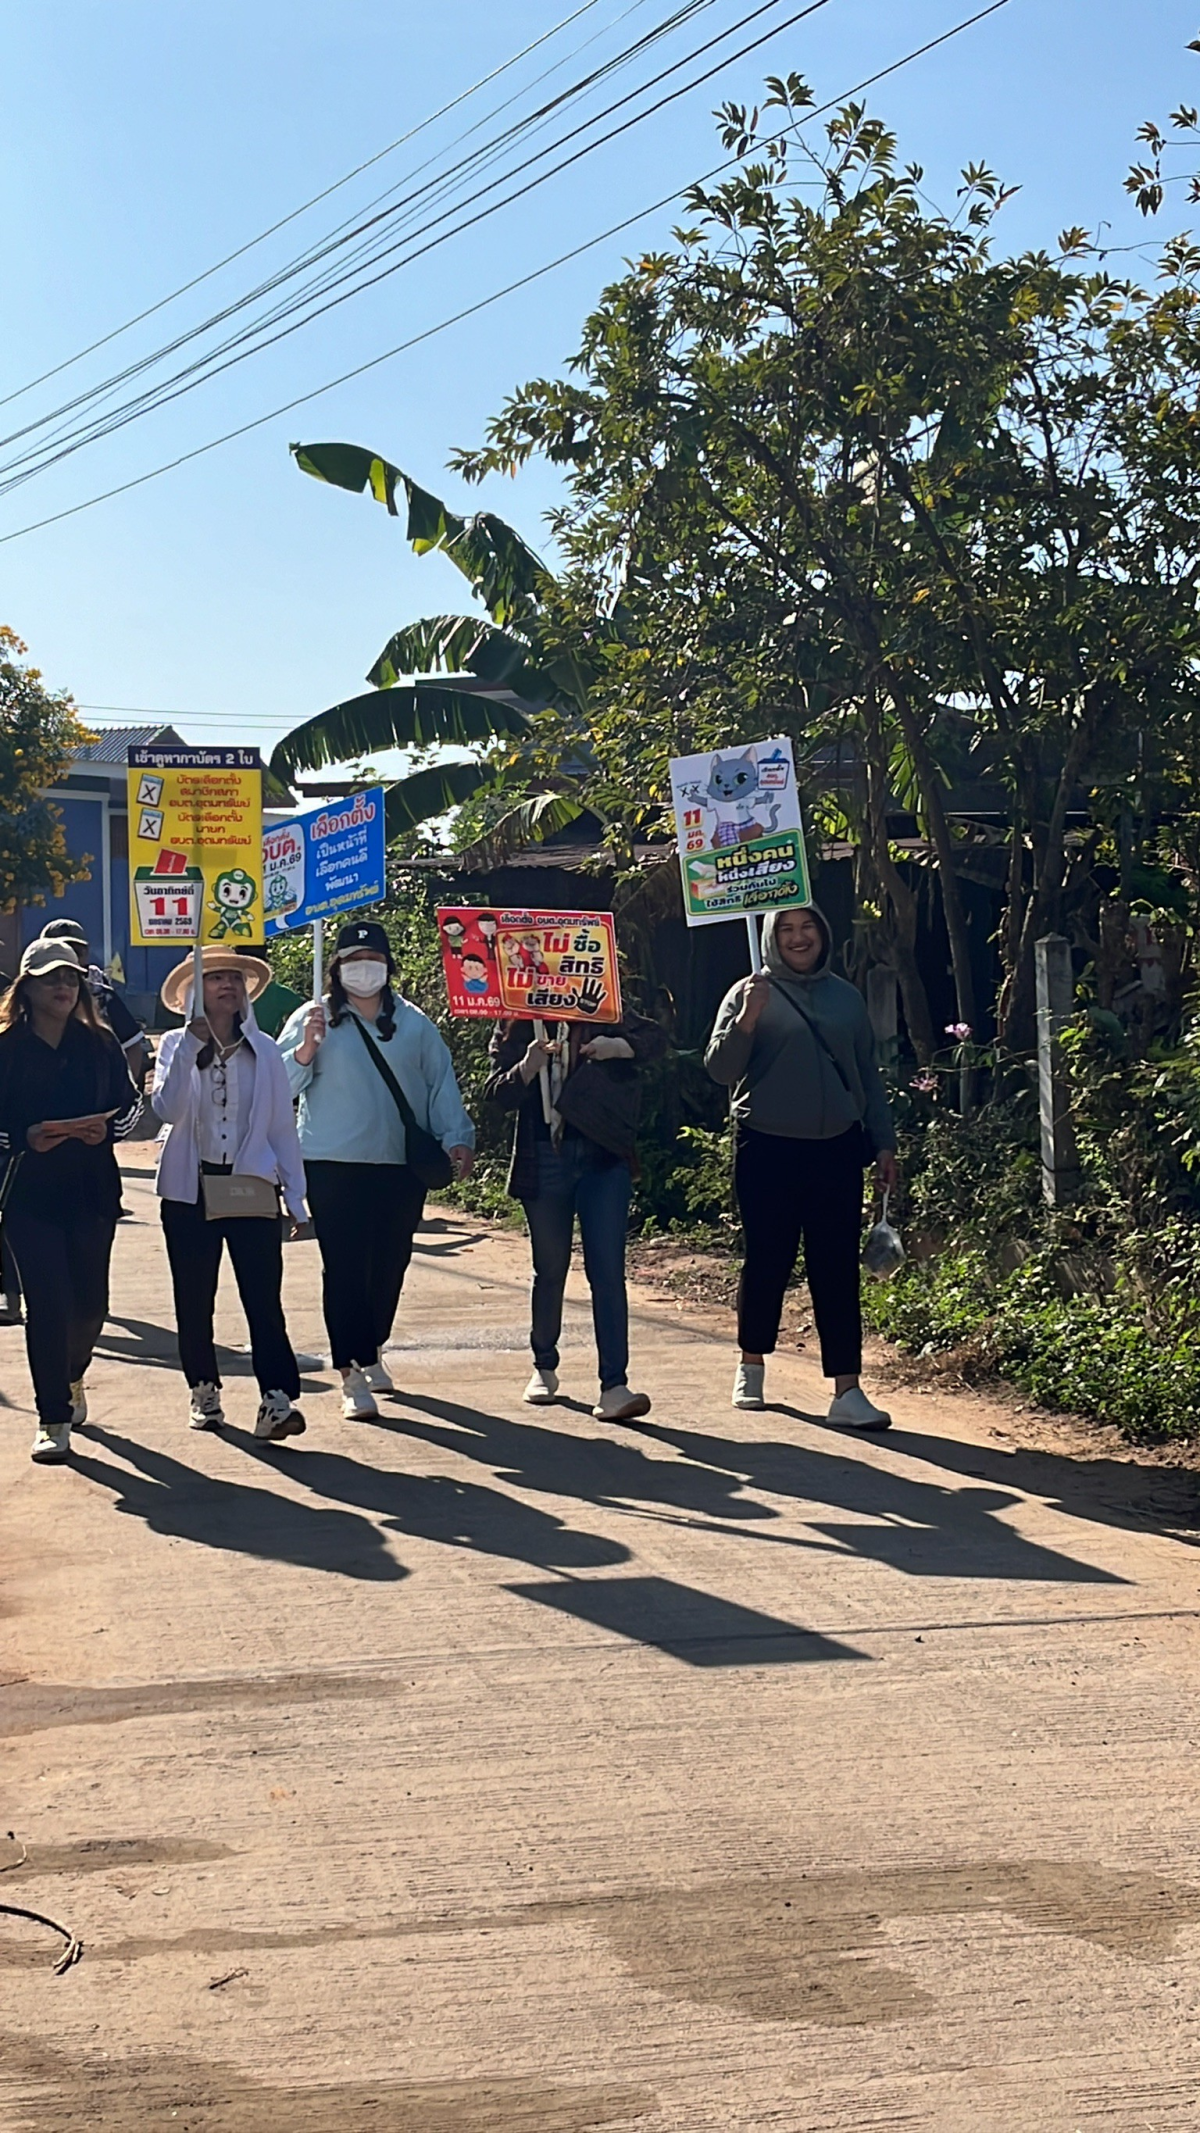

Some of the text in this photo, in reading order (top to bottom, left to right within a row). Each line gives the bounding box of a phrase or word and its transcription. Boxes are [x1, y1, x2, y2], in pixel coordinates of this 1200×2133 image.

[135, 750, 253, 768] เข้าคูหากาบัตร 2 ใบ
[310, 794, 375, 840] เลือกตั้ง
[683, 809, 701, 827] 11
[316, 826, 368, 859] เป็นหน้าที่
[686, 839, 704, 851] 69
[315, 847, 368, 877] เลือกคนดี
[716, 845, 794, 869] หนึ่งคน
[717, 860, 796, 883] หนึ่งเสียง
[325, 872, 359, 891] พัฒนา
[149, 897, 188, 916] 11
[357, 929, 368, 939] P
[543, 928, 602, 953] ไม่ ซื้อ
[507, 967, 566, 989] ไม่ ขาย
[452, 996, 464, 1006] 11
[527, 989, 577, 1007] เสียง
